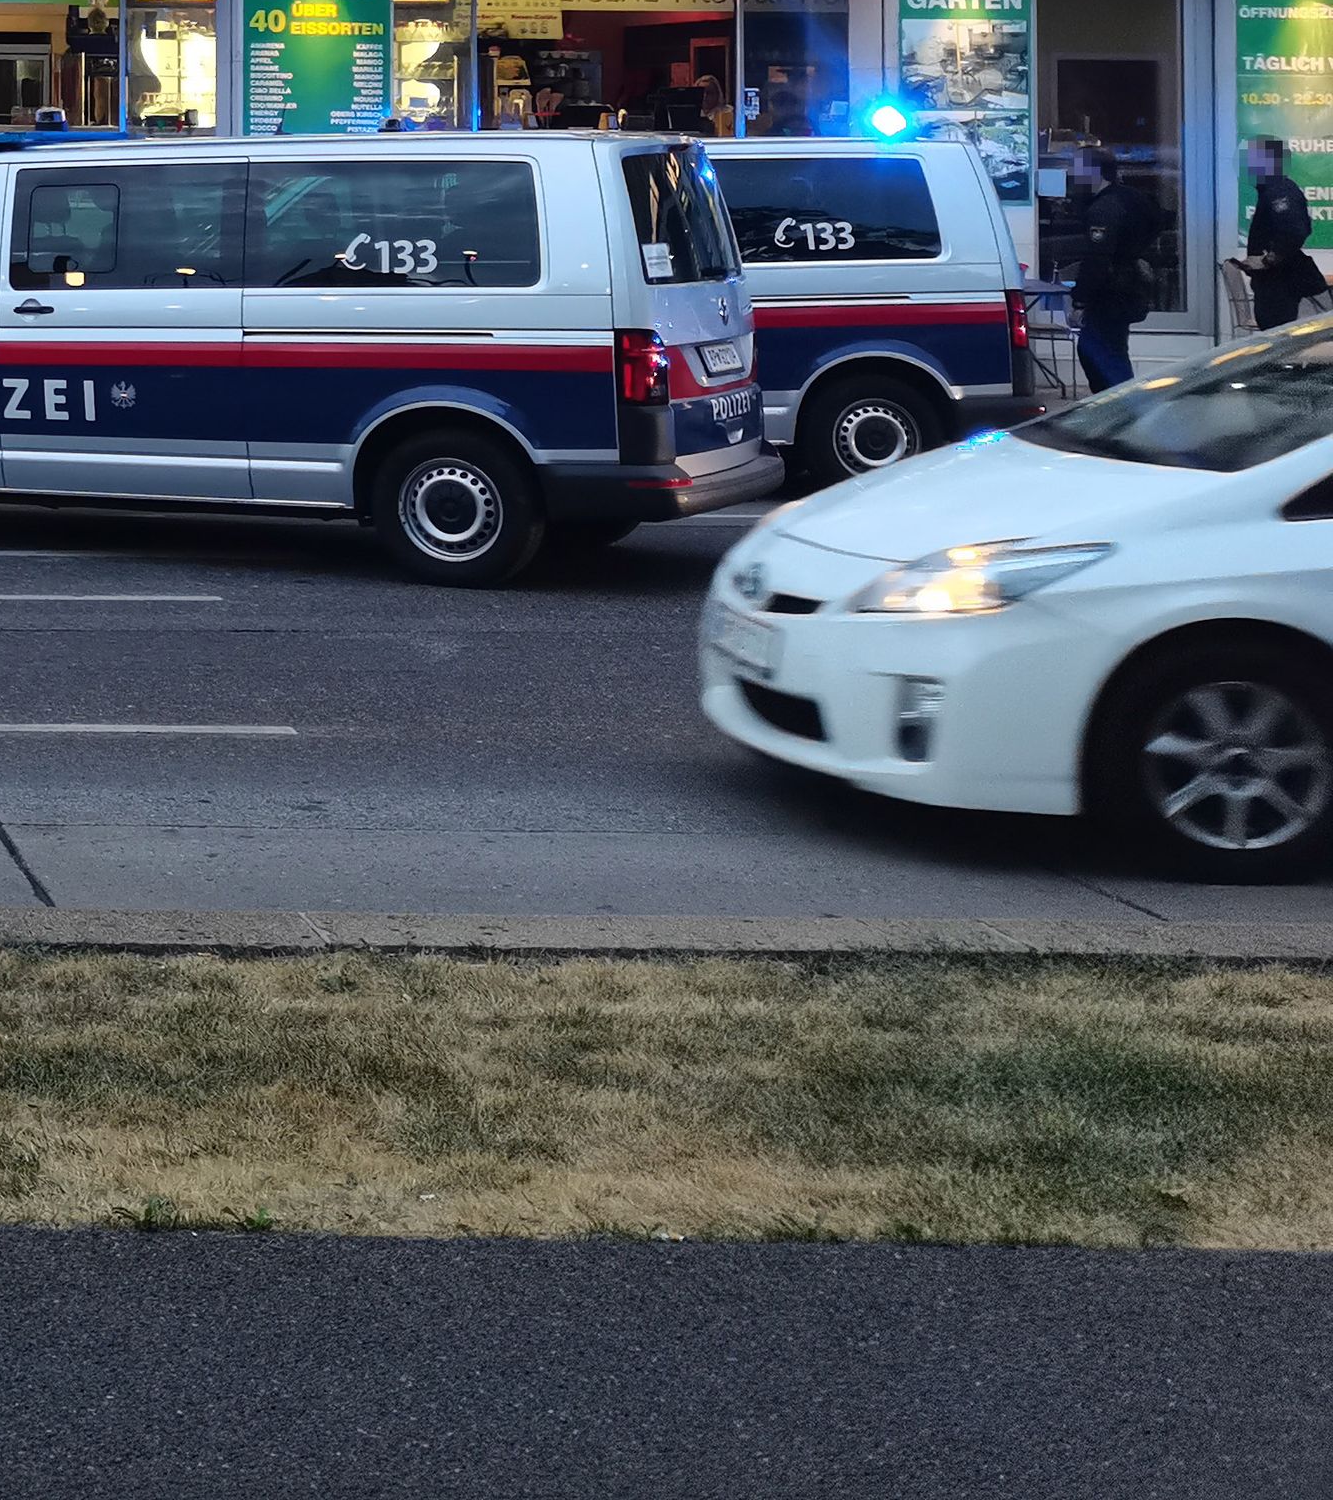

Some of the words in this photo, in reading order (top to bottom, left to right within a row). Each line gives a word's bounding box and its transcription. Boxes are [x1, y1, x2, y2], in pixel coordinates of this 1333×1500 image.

[249, 9, 286, 33] 40
[291, 0, 337, 18] ÜBER
[290, 21, 383, 36] EISSORTEN
[1242, 53, 1324, 73] TÄGLICH
[799, 221, 856, 251] 133
[374, 239, 438, 274] 133
[710, 390, 751, 421] POLIZEI
